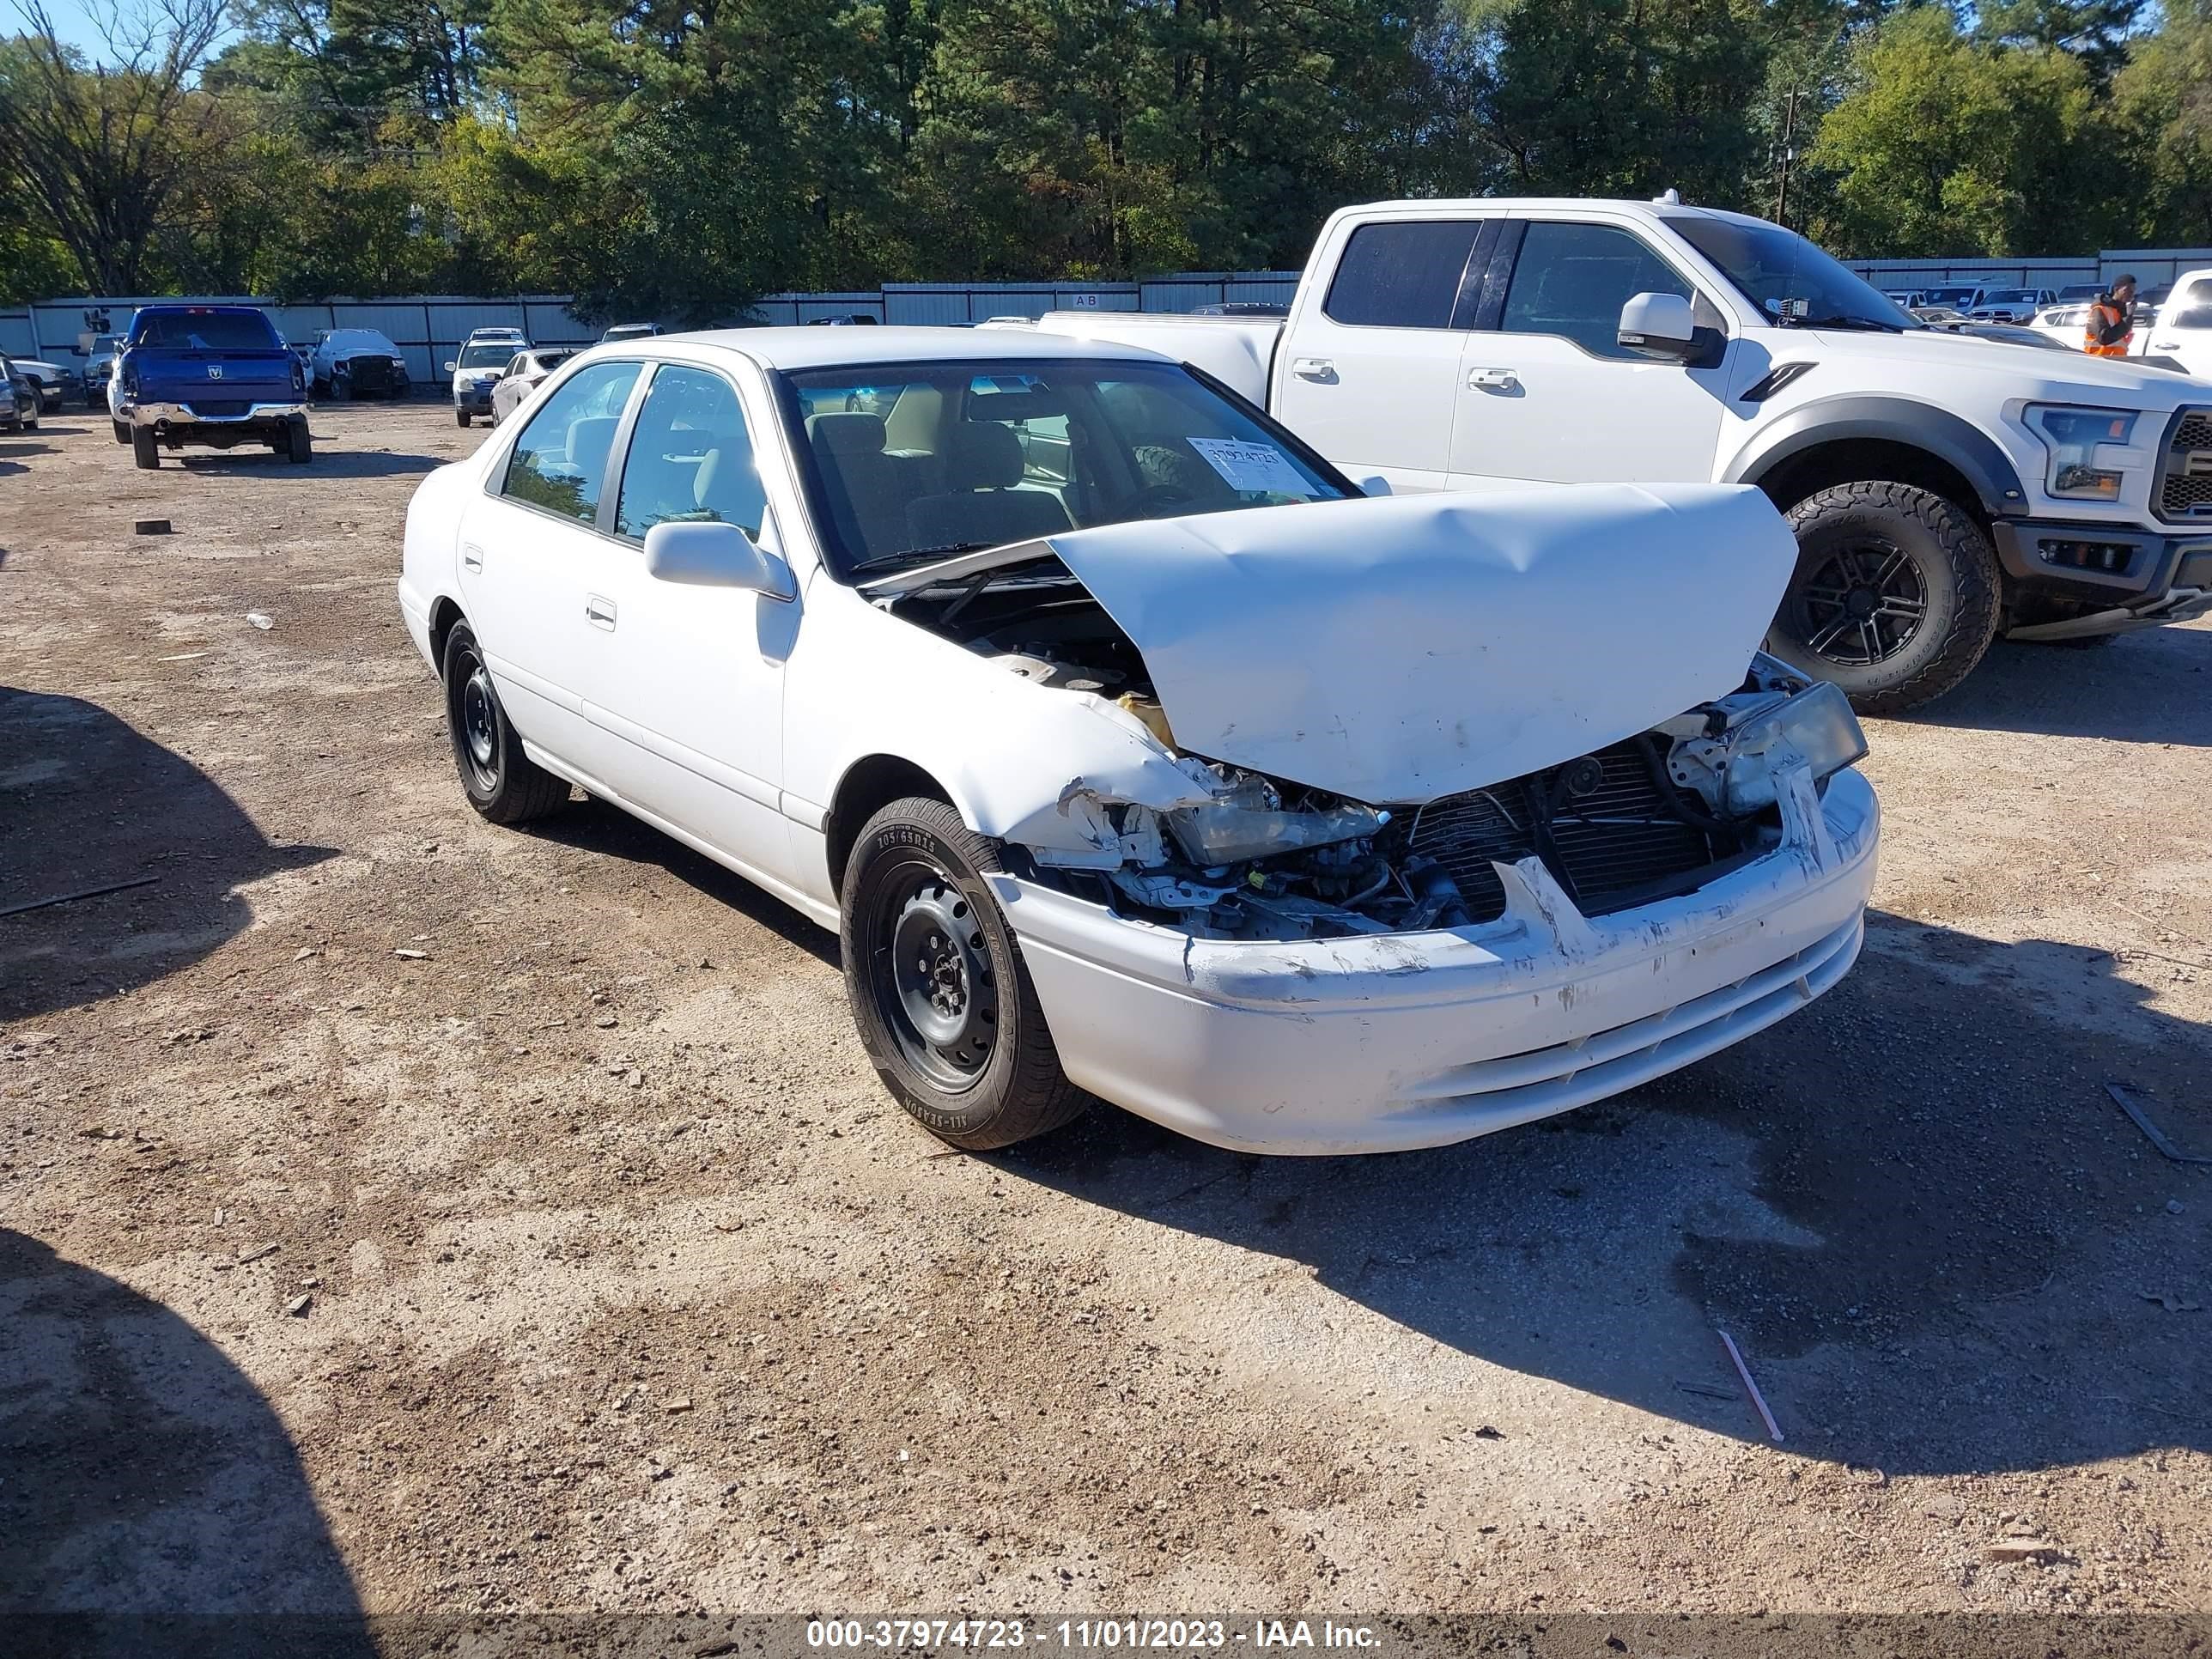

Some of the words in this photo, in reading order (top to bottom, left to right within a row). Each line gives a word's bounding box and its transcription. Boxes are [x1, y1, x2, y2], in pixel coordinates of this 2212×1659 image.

[1077, 295, 1085, 306] A
[1088, 295, 1097, 306] B
[1208, 449, 1279, 465] 37974723
[902, 1097, 968, 1128] ALL-SEASON
